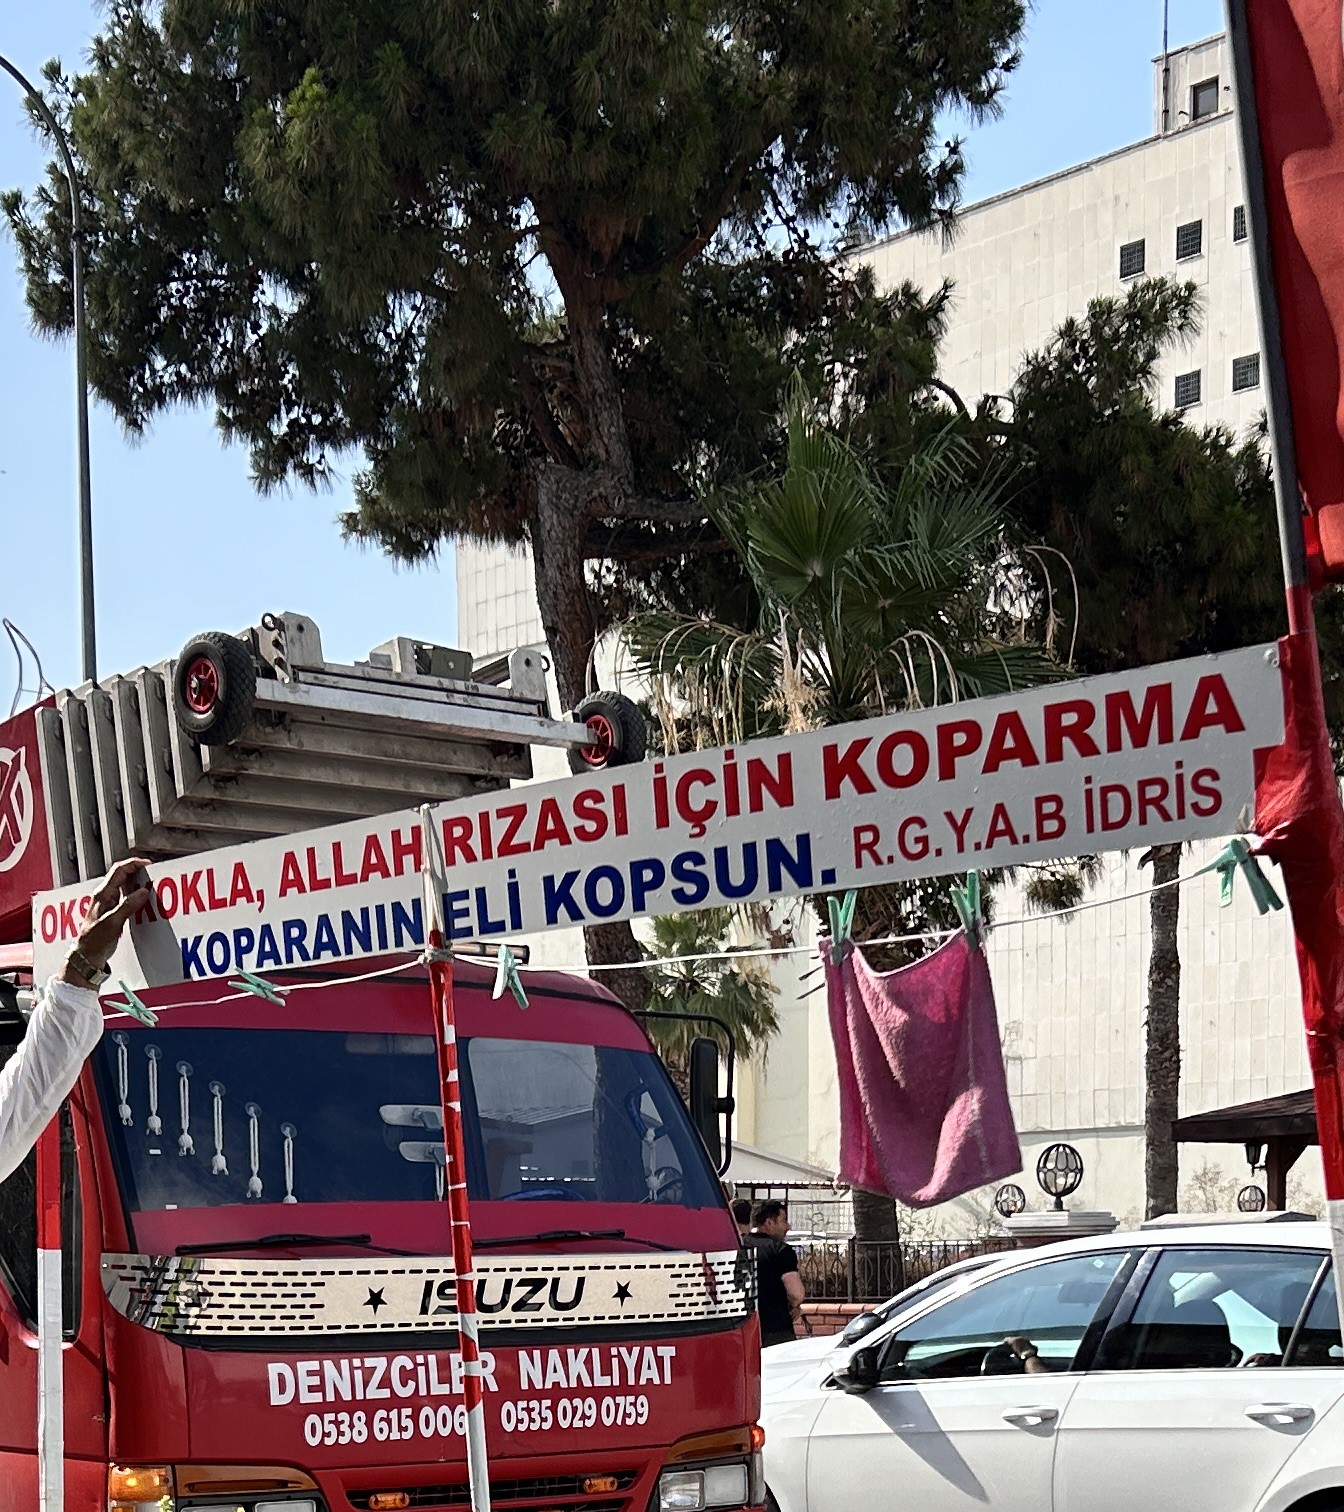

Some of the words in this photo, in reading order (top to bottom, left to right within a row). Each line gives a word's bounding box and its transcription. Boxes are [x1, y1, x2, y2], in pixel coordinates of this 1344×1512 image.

[278, 824, 422, 898] ALLAH
[442, 783, 630, 867] RIZASI
[654, 748, 795, 838] İÇİN
[822, 673, 1245, 800] KOPARMA
[181, 897, 424, 979] KOPARANIN
[442, 867, 521, 940] ELİ
[543, 832, 838, 926] KOPSUN.
[854, 794, 1068, 868] R.G.Y.A.B
[1083, 759, 1224, 834] İDRİS
[419, 1275, 586, 1316] ISUZU
[304, 1411, 368, 1447] 0538
[373, 1407, 414, 1441] 615
[418, 1404, 467, 1439] 006
[500, 1398, 554, 1433] 0535
[557, 1396, 597, 1429] 029
[600, 1394, 649, 1427] 0759
